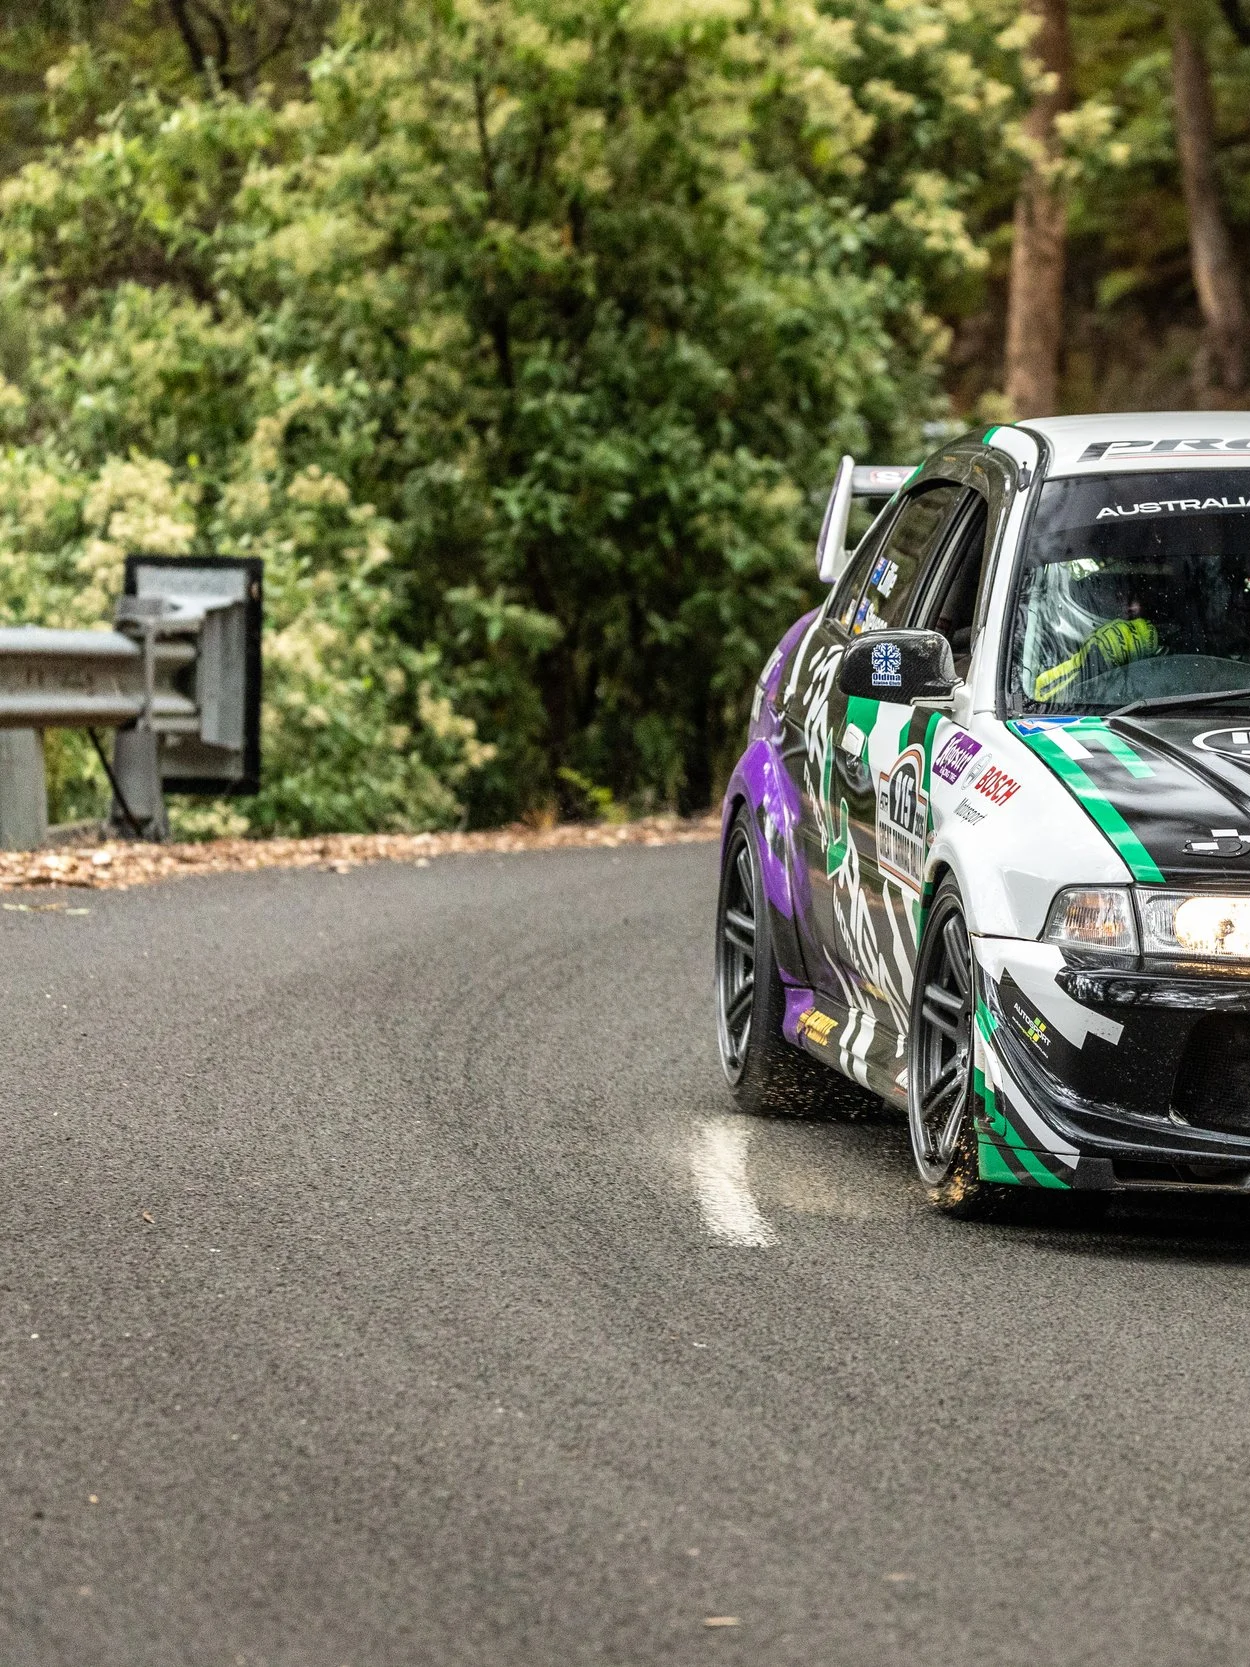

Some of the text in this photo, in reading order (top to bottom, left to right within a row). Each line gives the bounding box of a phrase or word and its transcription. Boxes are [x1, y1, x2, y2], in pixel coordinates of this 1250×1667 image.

[872, 673, 902, 681] Oldina
[893, 770, 915, 829] 915
[974, 765, 1022, 807] BOSCH
[1013, 1002, 1052, 1046] AUTOSPORT
